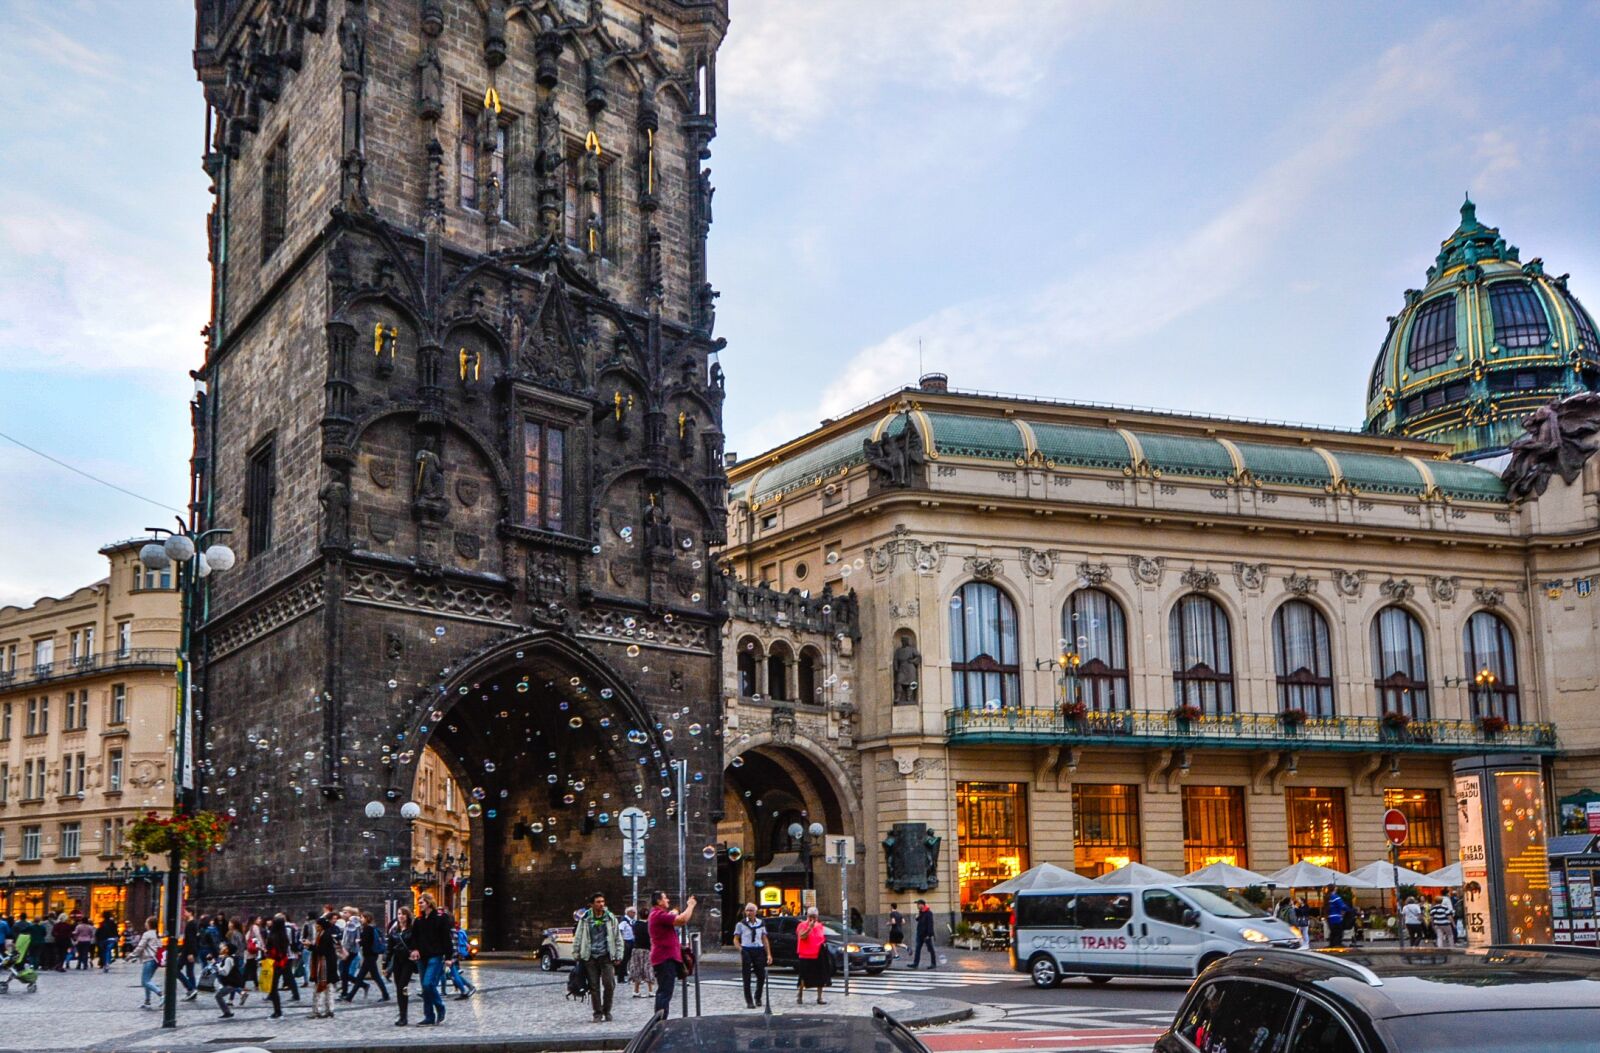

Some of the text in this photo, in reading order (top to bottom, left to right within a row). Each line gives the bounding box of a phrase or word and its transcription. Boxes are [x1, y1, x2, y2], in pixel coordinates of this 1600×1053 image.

[1467, 845, 1483, 853] YEAR
[1031, 935, 1171, 951] CZECH TRANS TOUR
